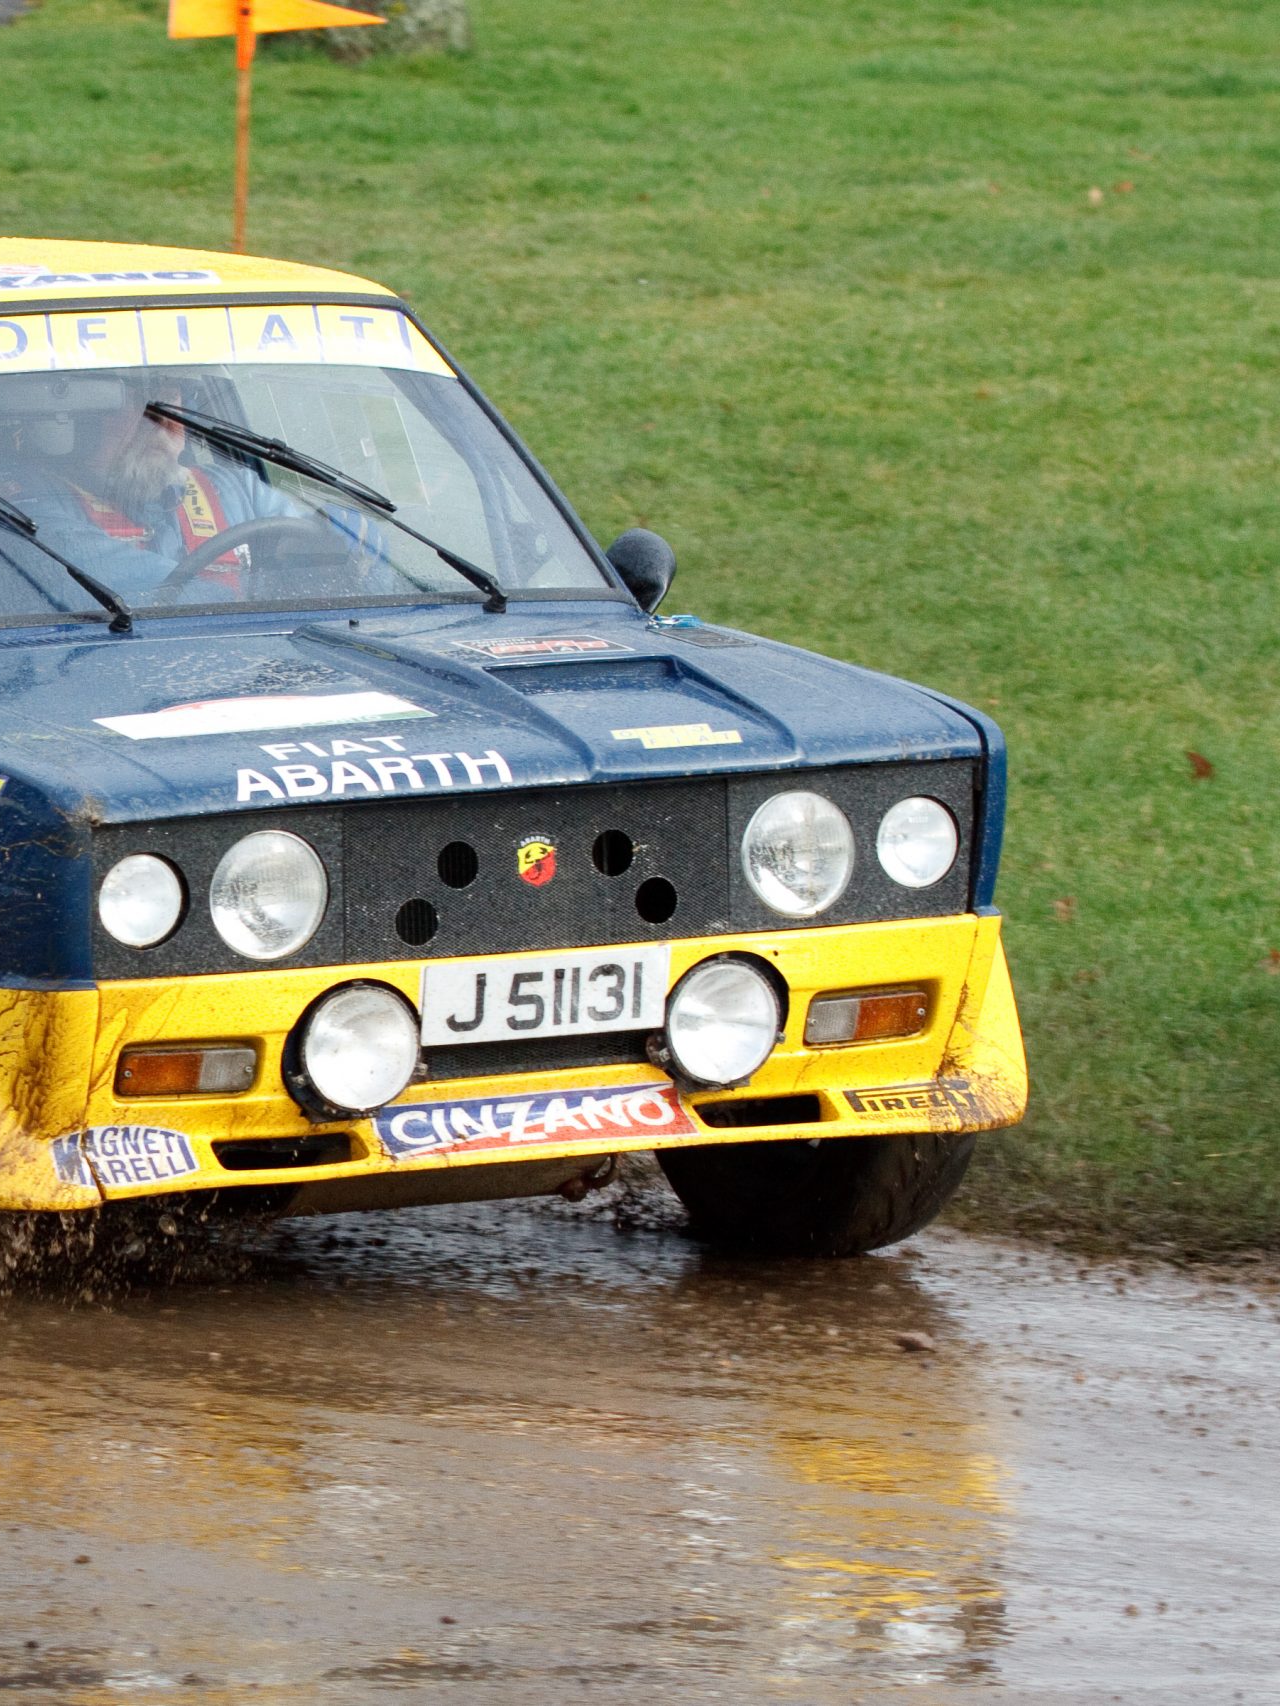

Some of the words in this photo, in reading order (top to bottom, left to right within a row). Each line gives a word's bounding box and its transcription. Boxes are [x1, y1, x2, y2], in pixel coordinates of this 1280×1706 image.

[259, 735, 407, 761] FIAT
[237, 750, 513, 801] ABARTH
[520, 835, 551, 847] ABARTH
[446, 973, 487, 1032] J
[506, 962, 643, 1031] 51131
[390, 1090, 676, 1146] CINZANO
[53, 1126, 195, 1170] MAGNETI
[58, 1155, 195, 1186] MARELLI
